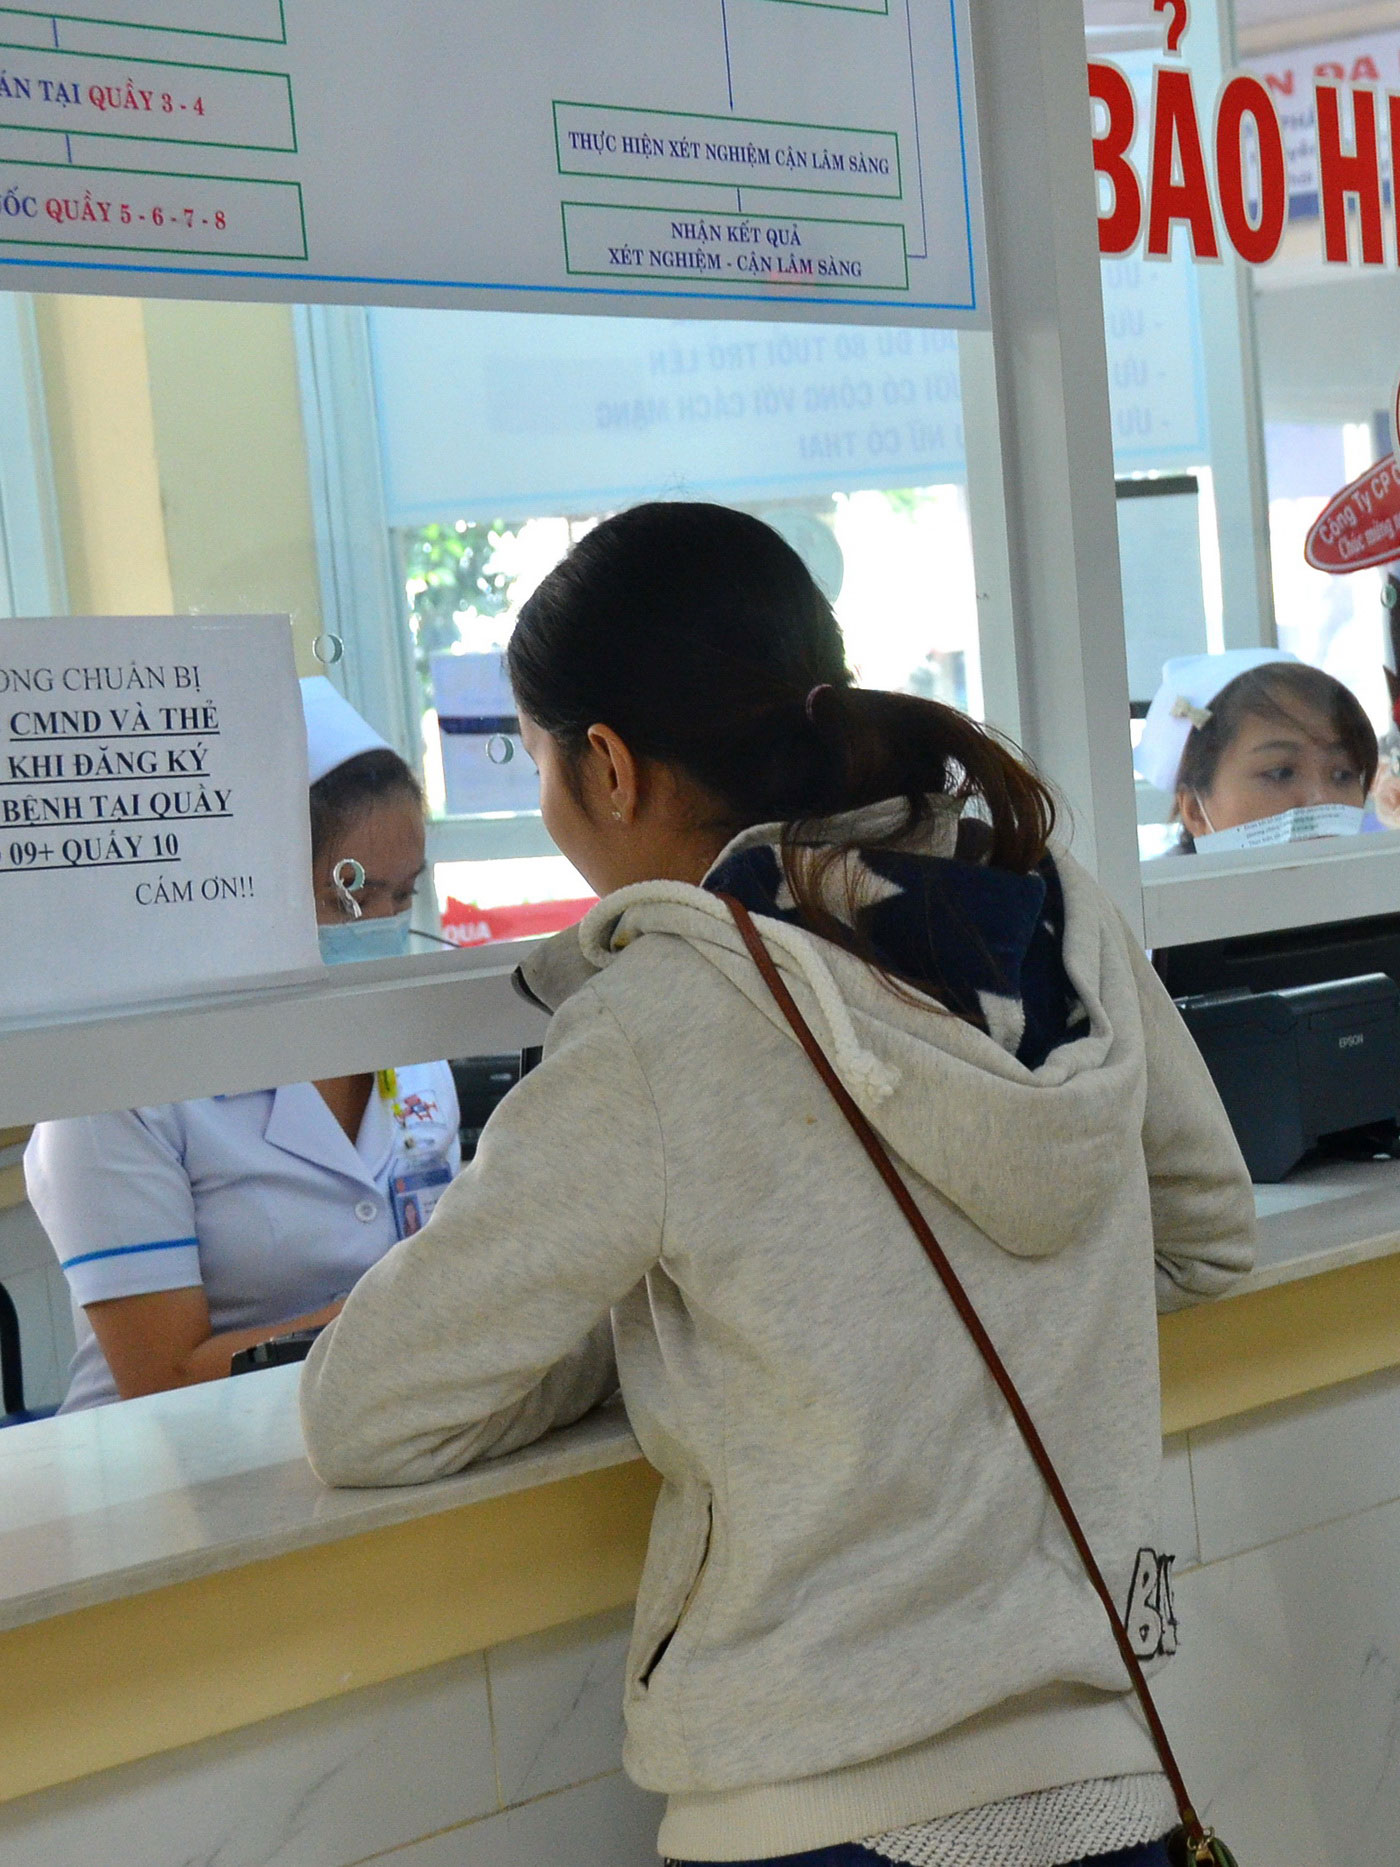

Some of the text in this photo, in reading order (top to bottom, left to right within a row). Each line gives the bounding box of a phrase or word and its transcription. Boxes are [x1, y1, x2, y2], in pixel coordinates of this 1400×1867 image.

[38, 79, 82, 108] TẠI
[88, 77, 154, 111] QUẦY
[161, 93, 173, 113] 3
[193, 96, 205, 116] 4
[1087, 0, 1285, 263] BẢO
[568, 131, 889, 175] THỰC HIỆN XÉT NGHIỆM CẬN LÂM SÀNG
[0, 185, 38, 218] ỐC
[45, 189, 111, 224] QUẦY
[120, 203, 132, 224] 5
[152, 206, 164, 227] 6
[183, 208, 194, 228] 7
[214, 210, 226, 230] 8
[671, 219, 801, 249] NHẬN KẾT QUẢ
[608, 244, 644, 266] XÉT
[649, 250, 721, 273] NGHIỆM
[737, 253, 772, 276] CẬN
[776, 253, 814, 275] LÂM
[818, 256, 862, 278] SÀNG
[1319, 505, 1358, 544] Công
[1351, 490, 1373, 513] Ty
[1370, 471, 1391, 499] CP
[174, 665, 201, 692] BỊ
[10, 699, 220, 736] CMND VÀ THẺ
[8, 742, 208, 779] KHI ĐĂNG KÝ
[3, 783, 233, 825] BỆNH TẠI QUẦY
[9, 841, 54, 866] 09+
[154, 832, 180, 857] 10
[201, 875, 254, 901] ƠN!!
[1338, 1033, 1364, 1049] EPSON
